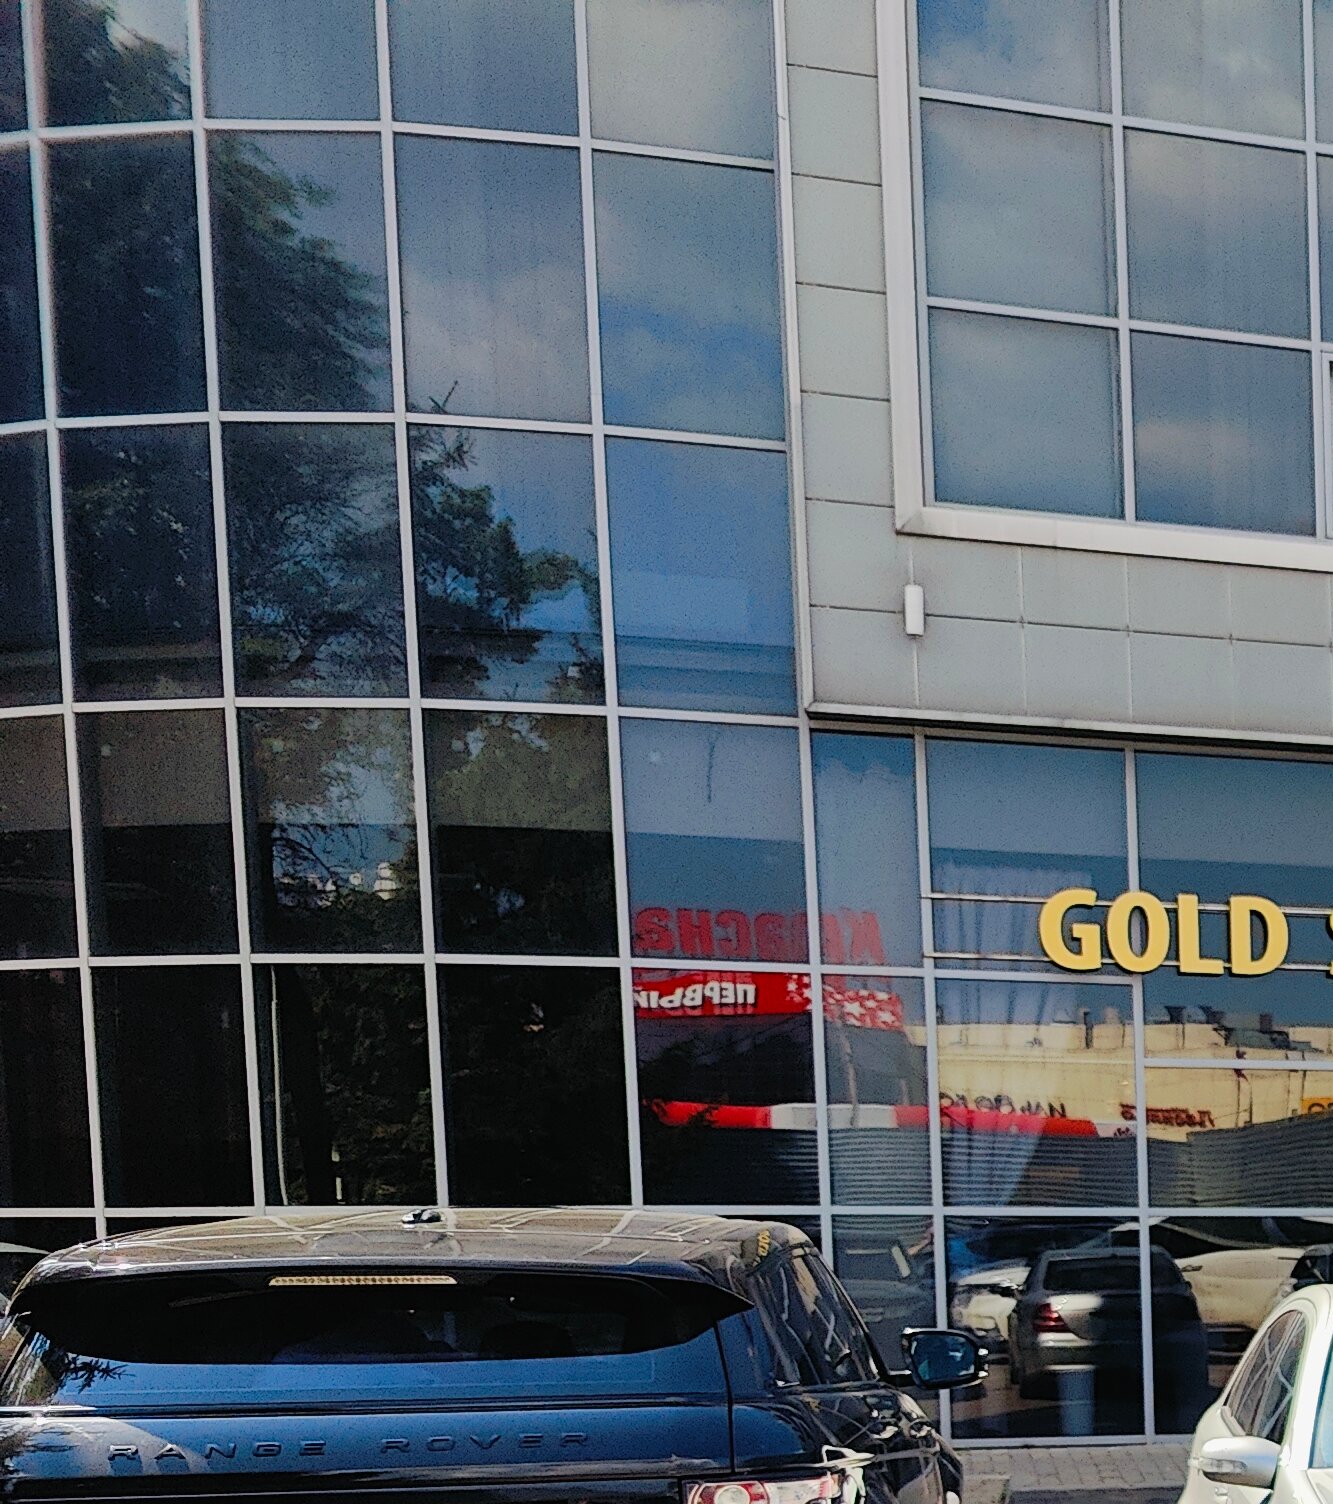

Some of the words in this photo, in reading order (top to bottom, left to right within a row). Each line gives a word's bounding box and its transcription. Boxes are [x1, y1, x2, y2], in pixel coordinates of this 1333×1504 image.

[1038, 887, 1290, 976] GOLD
[107, 1440, 328, 1462] RANGE
[380, 1431, 590, 1454] ROVER
